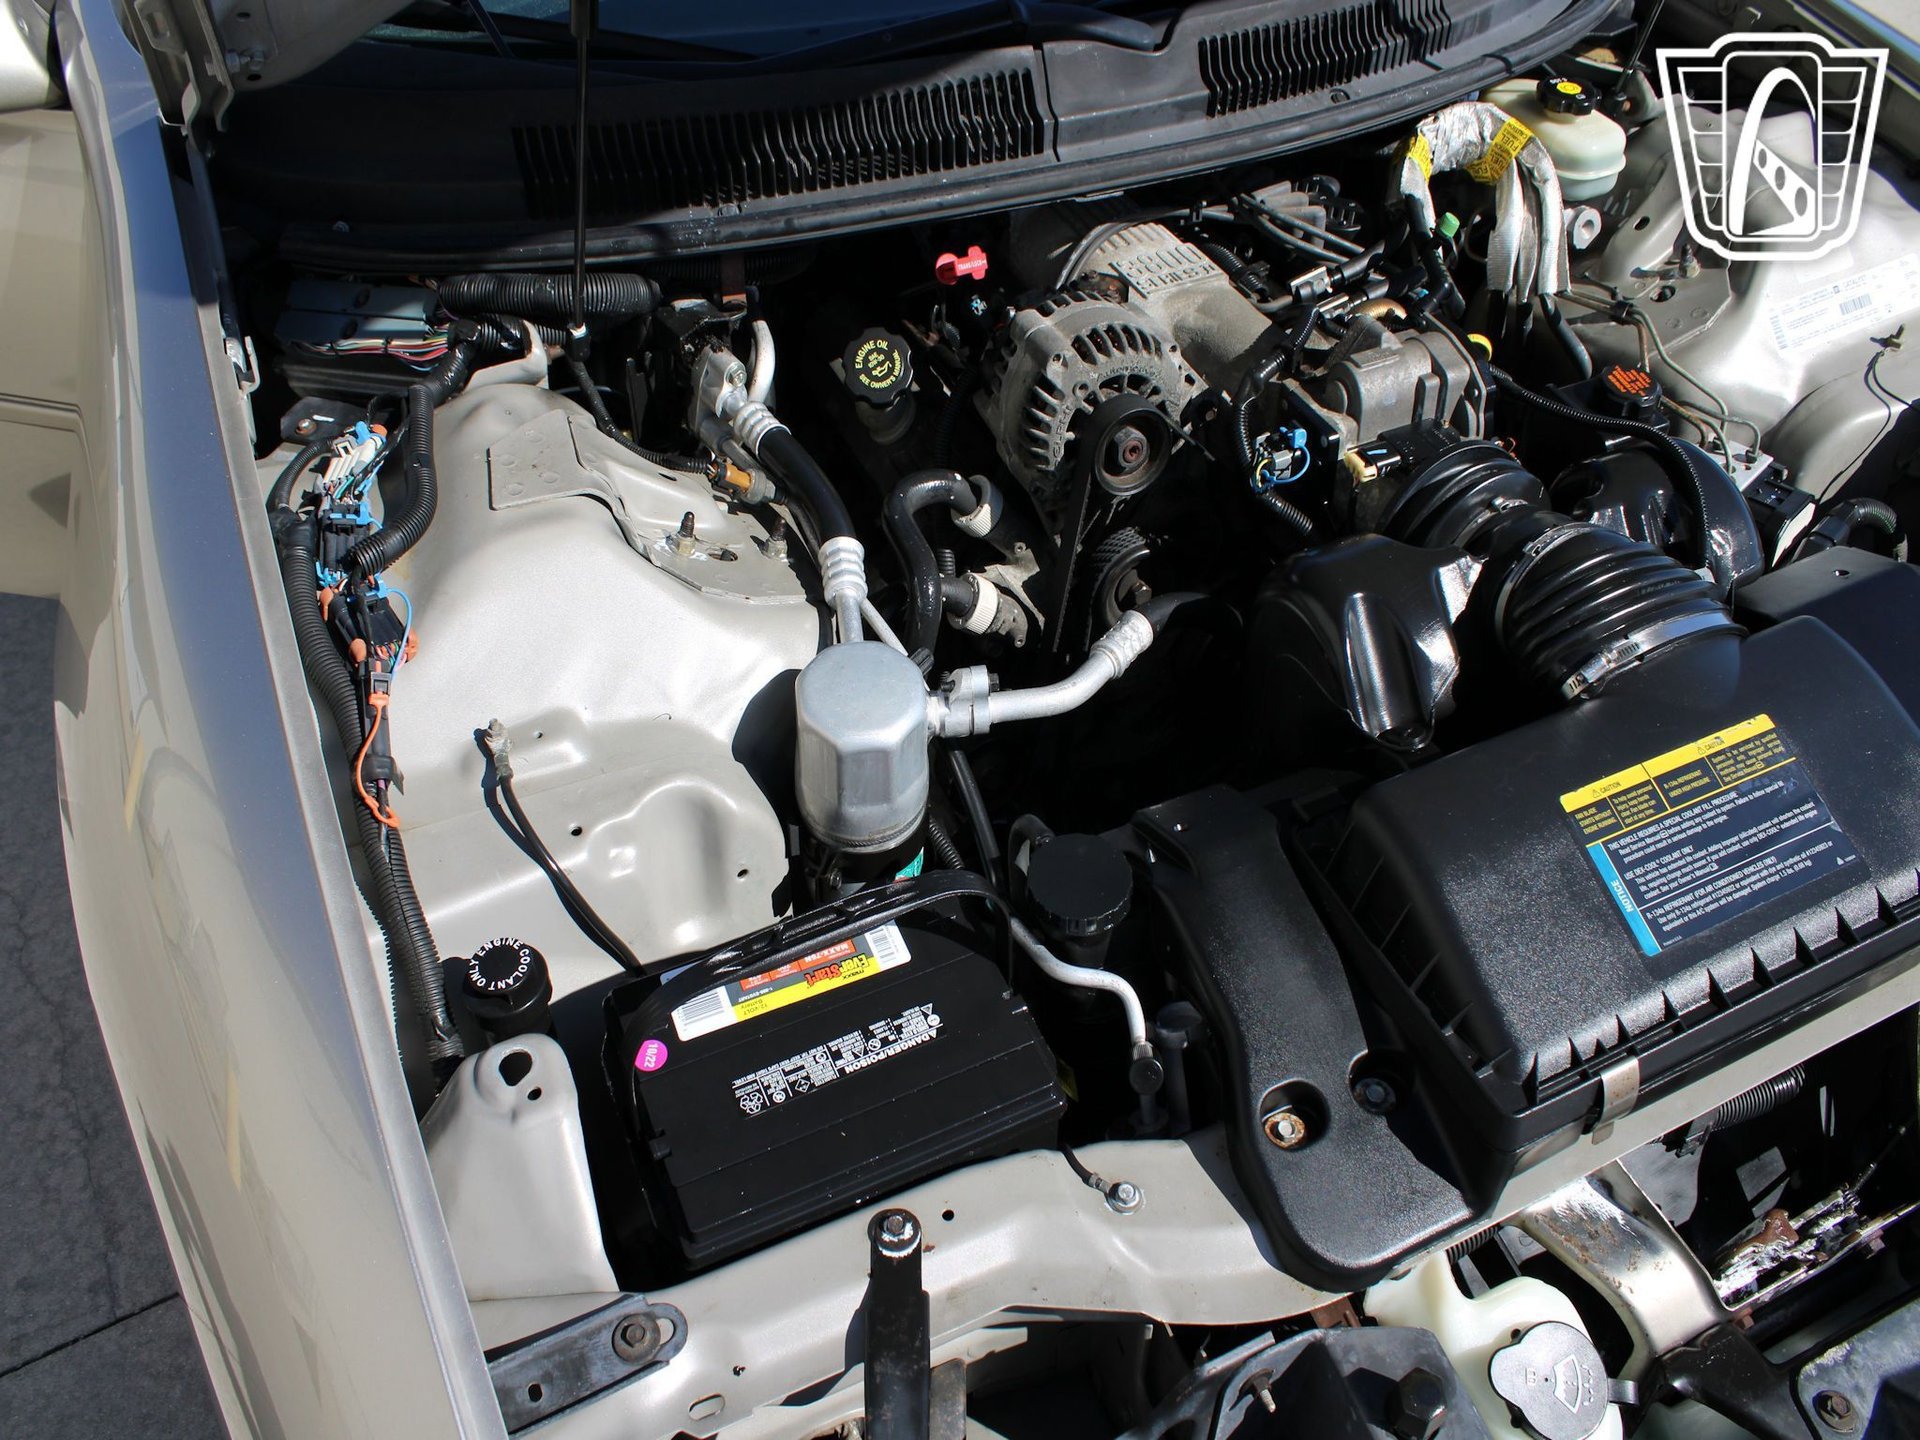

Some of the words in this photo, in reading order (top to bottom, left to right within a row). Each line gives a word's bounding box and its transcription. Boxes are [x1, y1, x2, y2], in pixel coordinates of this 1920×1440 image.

[1500, 133, 1519, 152] FUEL
[855, 340, 875, 368] ENGINE
[876, 340, 888, 350] OIL
[859, 373, 870, 385] SEE
[892, 349, 901, 375] MANUAL
[1598, 780, 1621, 794] CAUTION
[1607, 840, 1620, 850] THIS
[1617, 833, 1638, 846] VEHICLE
[1636, 823, 1660, 838] REQUIRES
[1662, 814, 1682, 827] SPECIAL
[1680, 805, 1703, 819] COOLANT
[1701, 801, 1712, 810] FILL
[1710, 790, 1738, 806] PROCEDURE
[1629, 840, 1646, 850] Service
[1644, 833, 1661, 844] Manual
[1666, 824, 1681, 835] before
[1679, 818, 1695, 830] adding
[1700, 809, 1716, 820] coolant
[1622, 850, 1645, 863] procedure
[1642, 844, 1656, 854] could
[1654, 839, 1668, 849] result
[1670, 831, 1687, 842] serious
[1685, 824, 1703, 837] damage
[1643, 869, 1660, 880] vehicle
[1666, 857, 1686, 870] extended
[1706, 842, 1722, 853] Adding
[1756, 820, 1772, 831] coolant
[1665, 869, 1682, 881] change
[1779, 817, 1799, 829] extended
[1623, 870, 1635, 880] USE
[1659, 849, 1682, 864] COOLANT
[1680, 844, 1695, 855] ONLY
[1693, 865, 1711, 876] Manual
[1610, 879, 1634, 912] NOTICE
[1662, 892, 1695, 911] REFRIGERANT
[1693, 887, 1706, 898] (FOR
[1704, 883, 1714, 893] AIR
[1711, 870, 1744, 889] CONDITIONED
[1741, 861, 1764, 875] VEHICLES
[1750, 879, 1767, 891] System
[477, 937, 522, 955] ENGINE
[469, 958, 486, 986] ONLY
[487, 948, 530, 990] COOLANT
[803, 951, 869, 987] EverStart
[740, 997, 762, 1009] Battery
[643, 1043, 658, 1067] 10/22
[844, 1032, 930, 1073] DANGER/POISON
